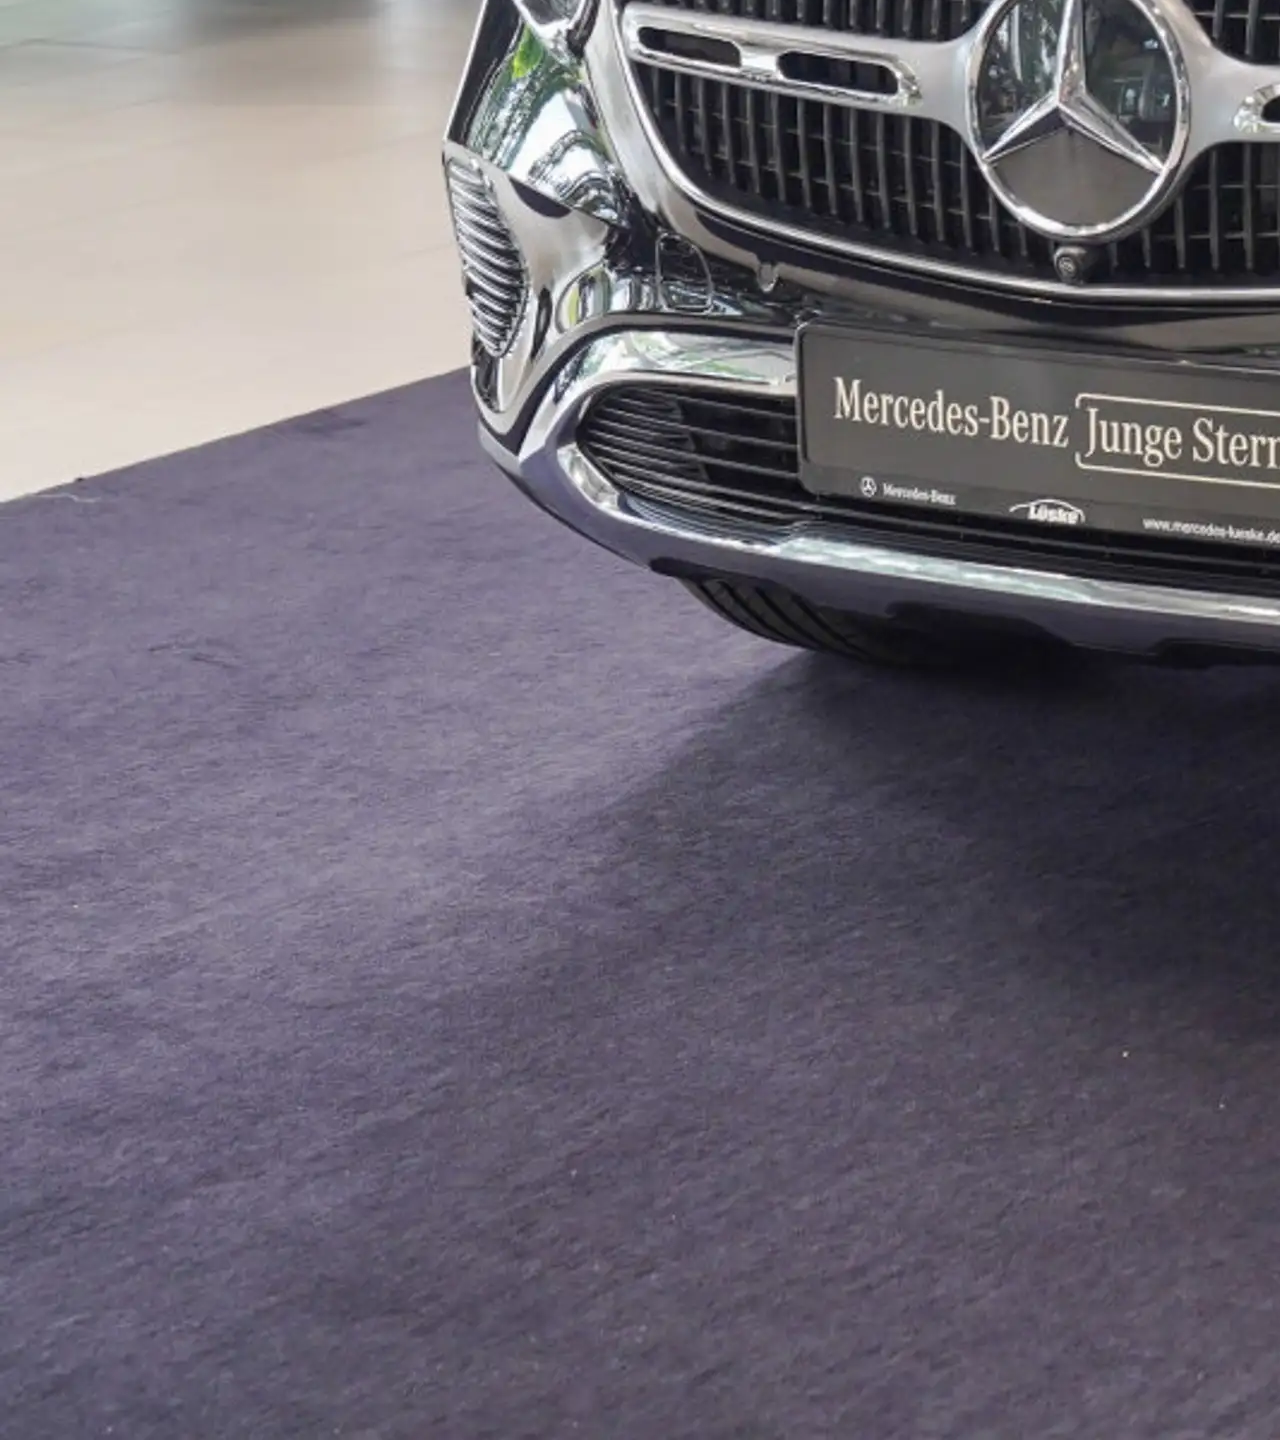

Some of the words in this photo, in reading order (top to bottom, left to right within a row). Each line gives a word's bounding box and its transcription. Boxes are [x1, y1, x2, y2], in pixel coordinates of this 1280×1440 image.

[833, 376, 1070, 448] Mercedes-Benz
[1083, 407, 1182, 467] Junge
[883, 482, 957, 506] Mercedes-Benz
